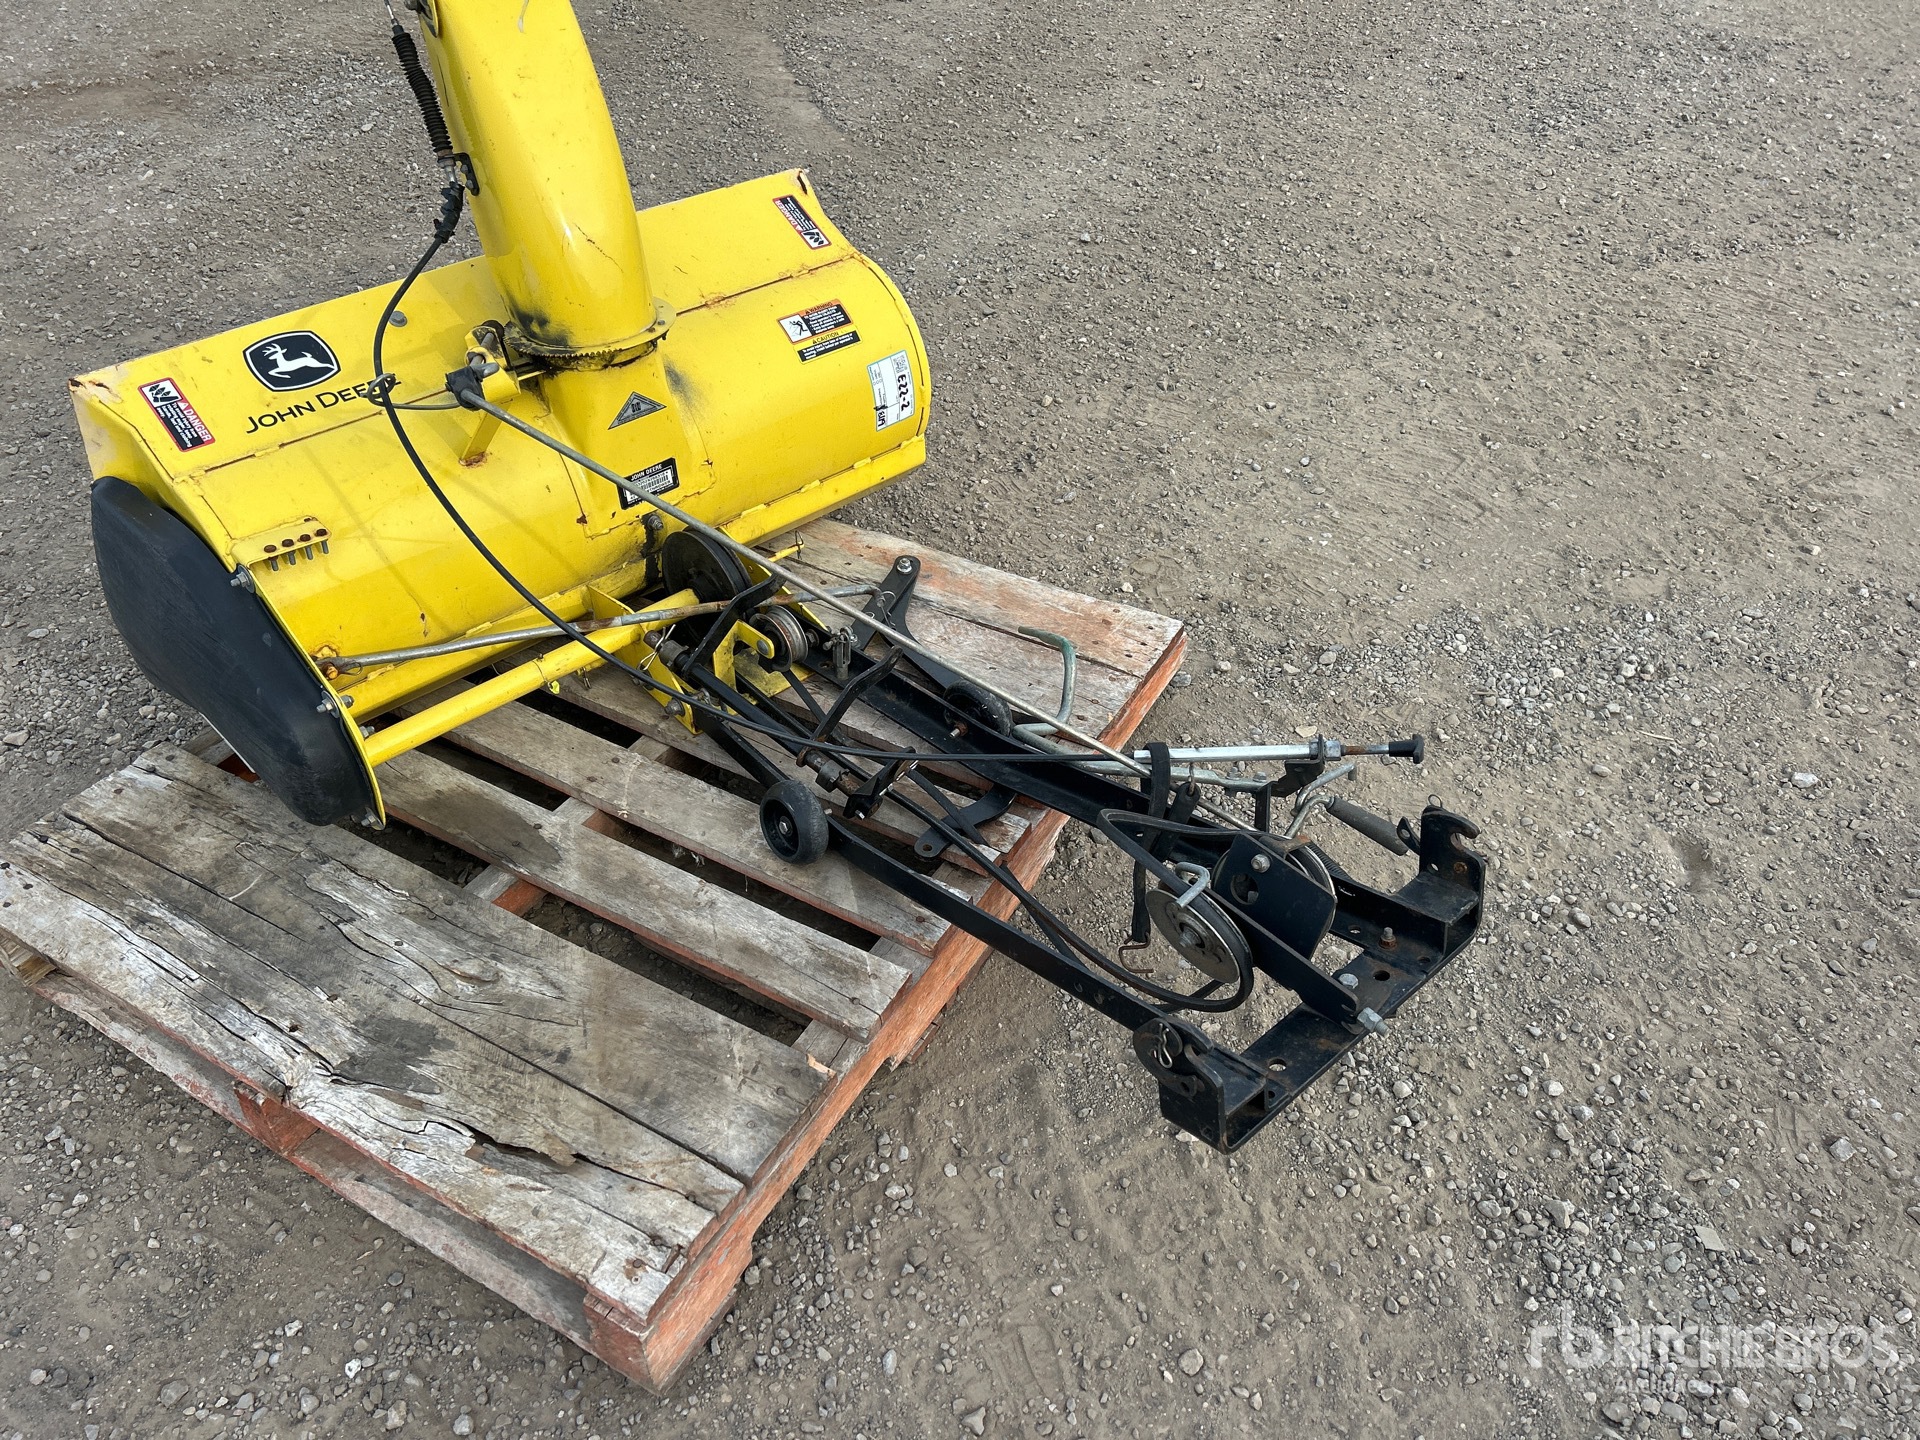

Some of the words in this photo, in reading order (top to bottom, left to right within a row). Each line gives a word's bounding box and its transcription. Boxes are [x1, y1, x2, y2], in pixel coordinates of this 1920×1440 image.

[775, 200, 798, 226] DANGER
[810, 302, 833, 313] WARNING
[816, 332, 839, 343] CAUTION
[897, 374, 910, 412] E22-2
[183, 408, 213, 442] DANGER
[246, 401, 316, 434] JOHN
[630, 471, 645, 481] JOHN
[645, 464, 662, 474] DEERE
